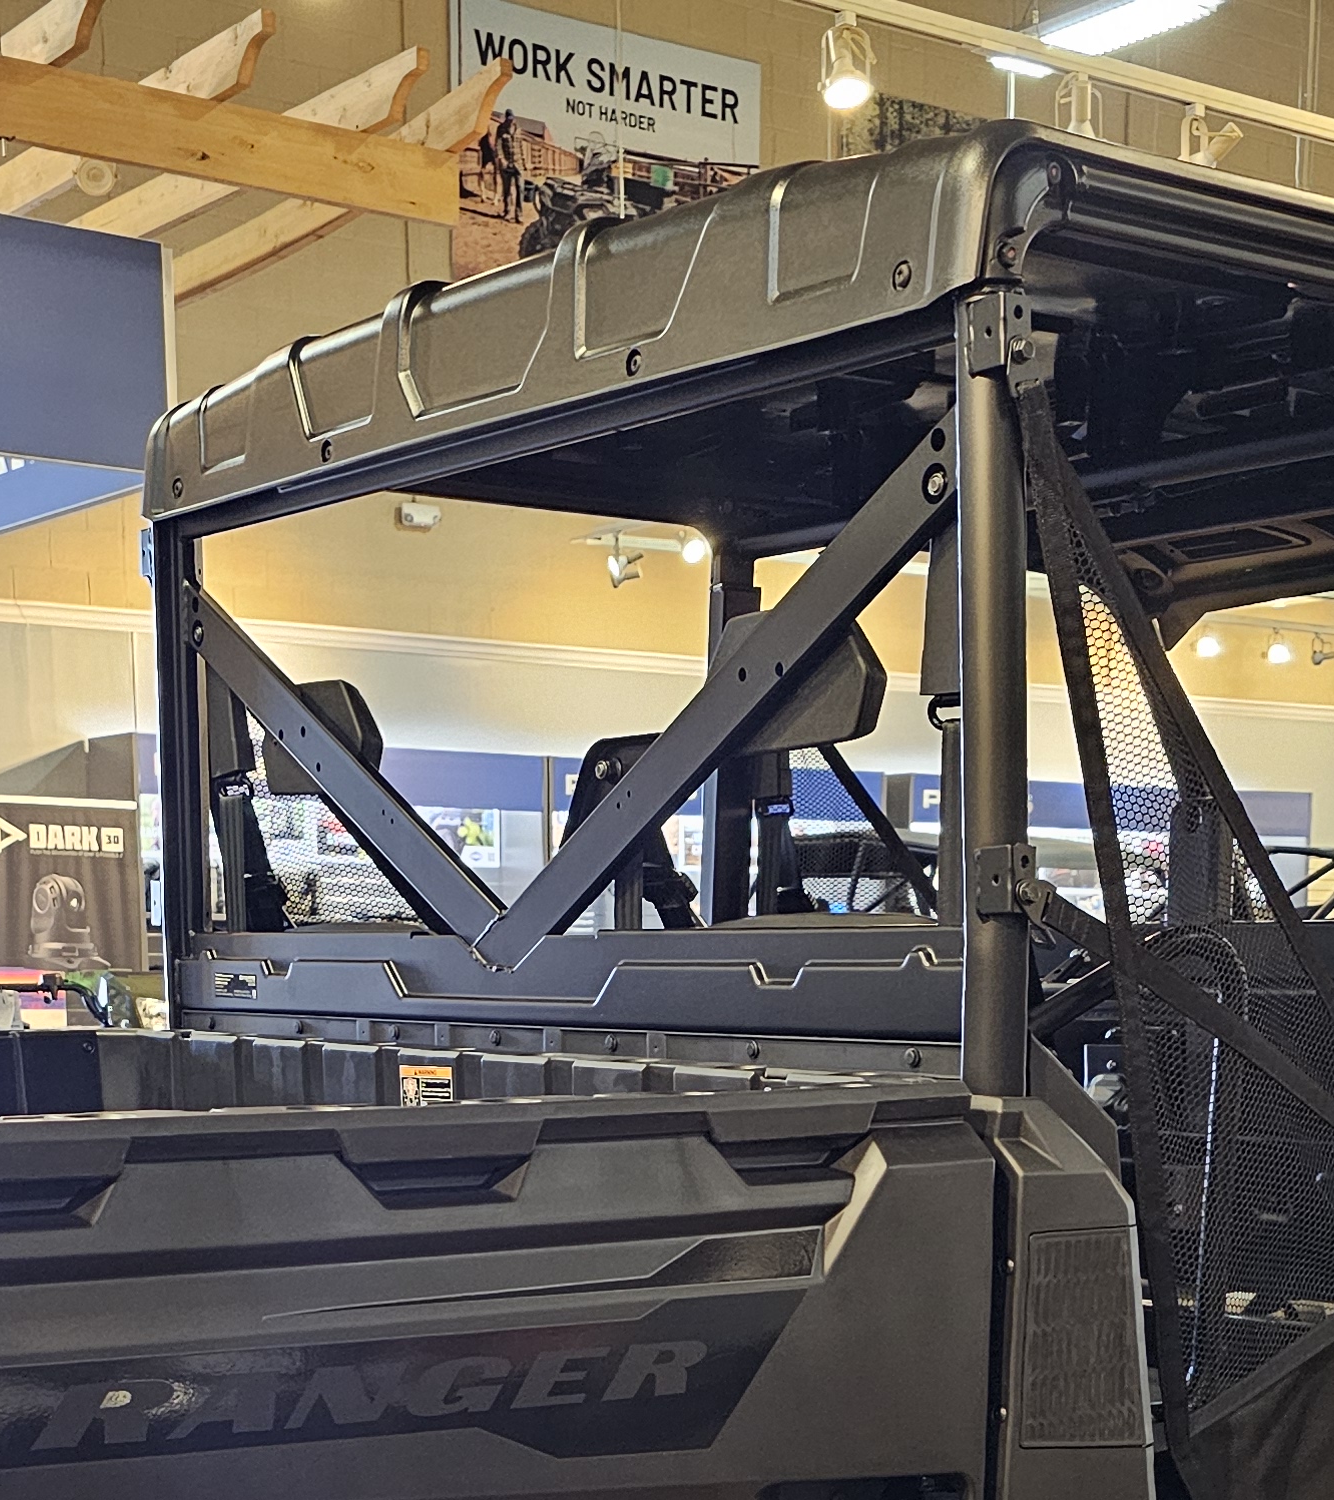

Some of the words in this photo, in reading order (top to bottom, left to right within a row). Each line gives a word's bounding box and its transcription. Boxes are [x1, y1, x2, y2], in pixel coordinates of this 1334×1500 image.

[473, 28, 575, 88] WORK
[586, 57, 739, 124] SMARTER
[566, 97, 595, 118] NOT
[599, 105, 656, 133] HARDER
[28, 824, 100, 851] DARK
[30, 1340, 708, 1451] RANGER
